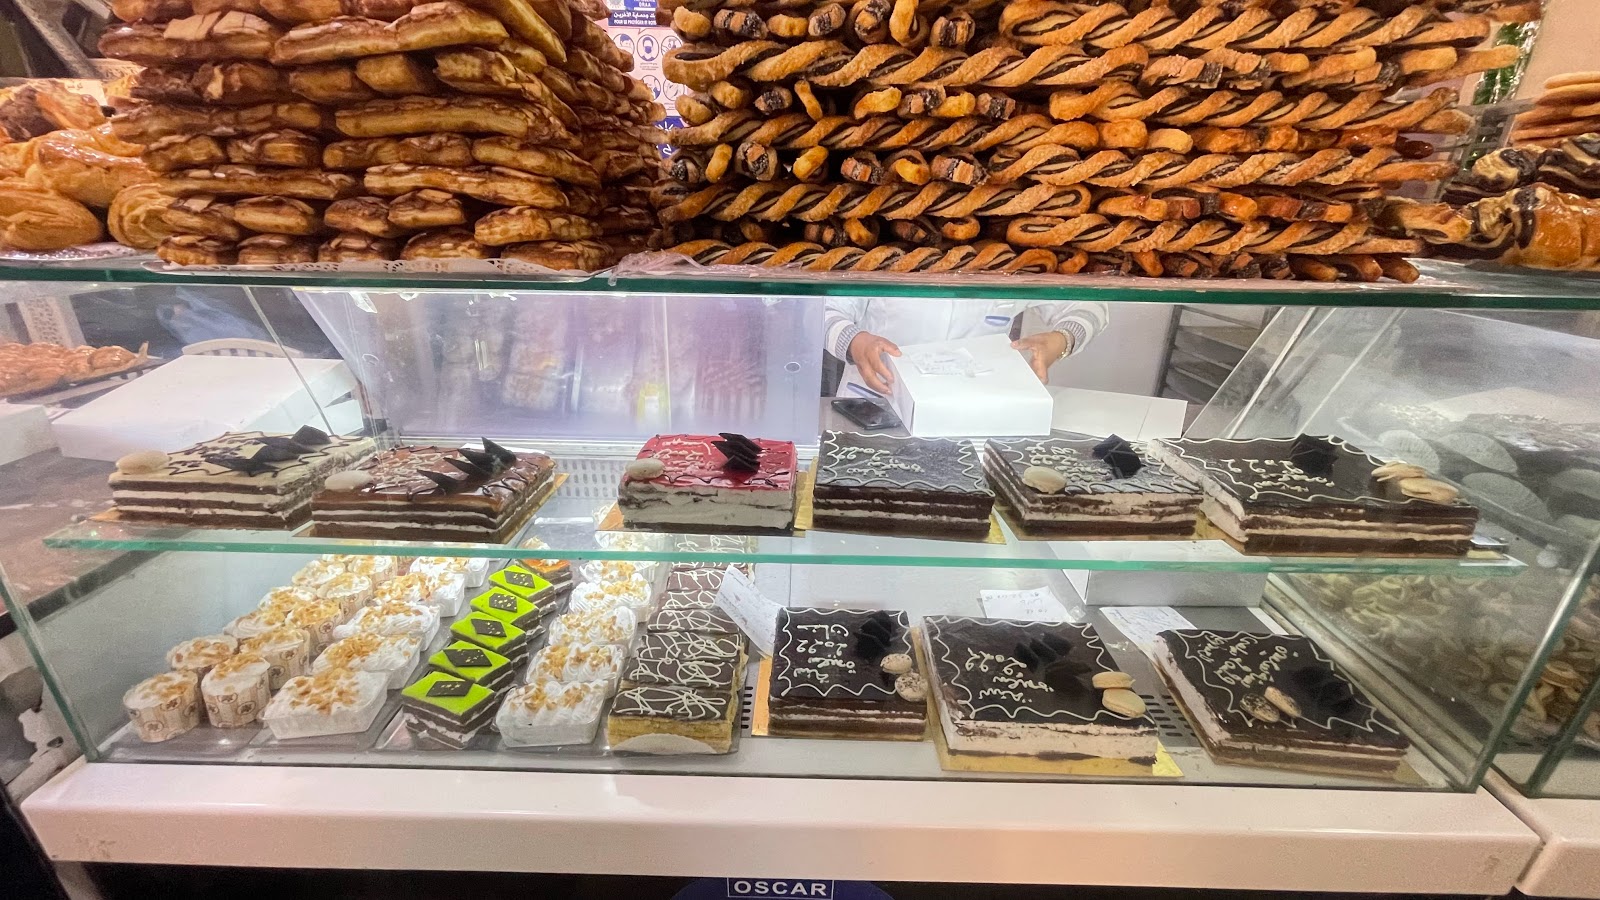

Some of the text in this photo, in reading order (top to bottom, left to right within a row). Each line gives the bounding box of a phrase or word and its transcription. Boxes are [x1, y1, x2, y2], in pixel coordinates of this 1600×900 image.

[796, 639, 848, 656] 2022
[807, 655, 856, 674] سعيدة
[793, 667, 829, 684] سنة
[978, 688, 1033, 703] سنة
[734, 880, 827, 896] OSCAR
